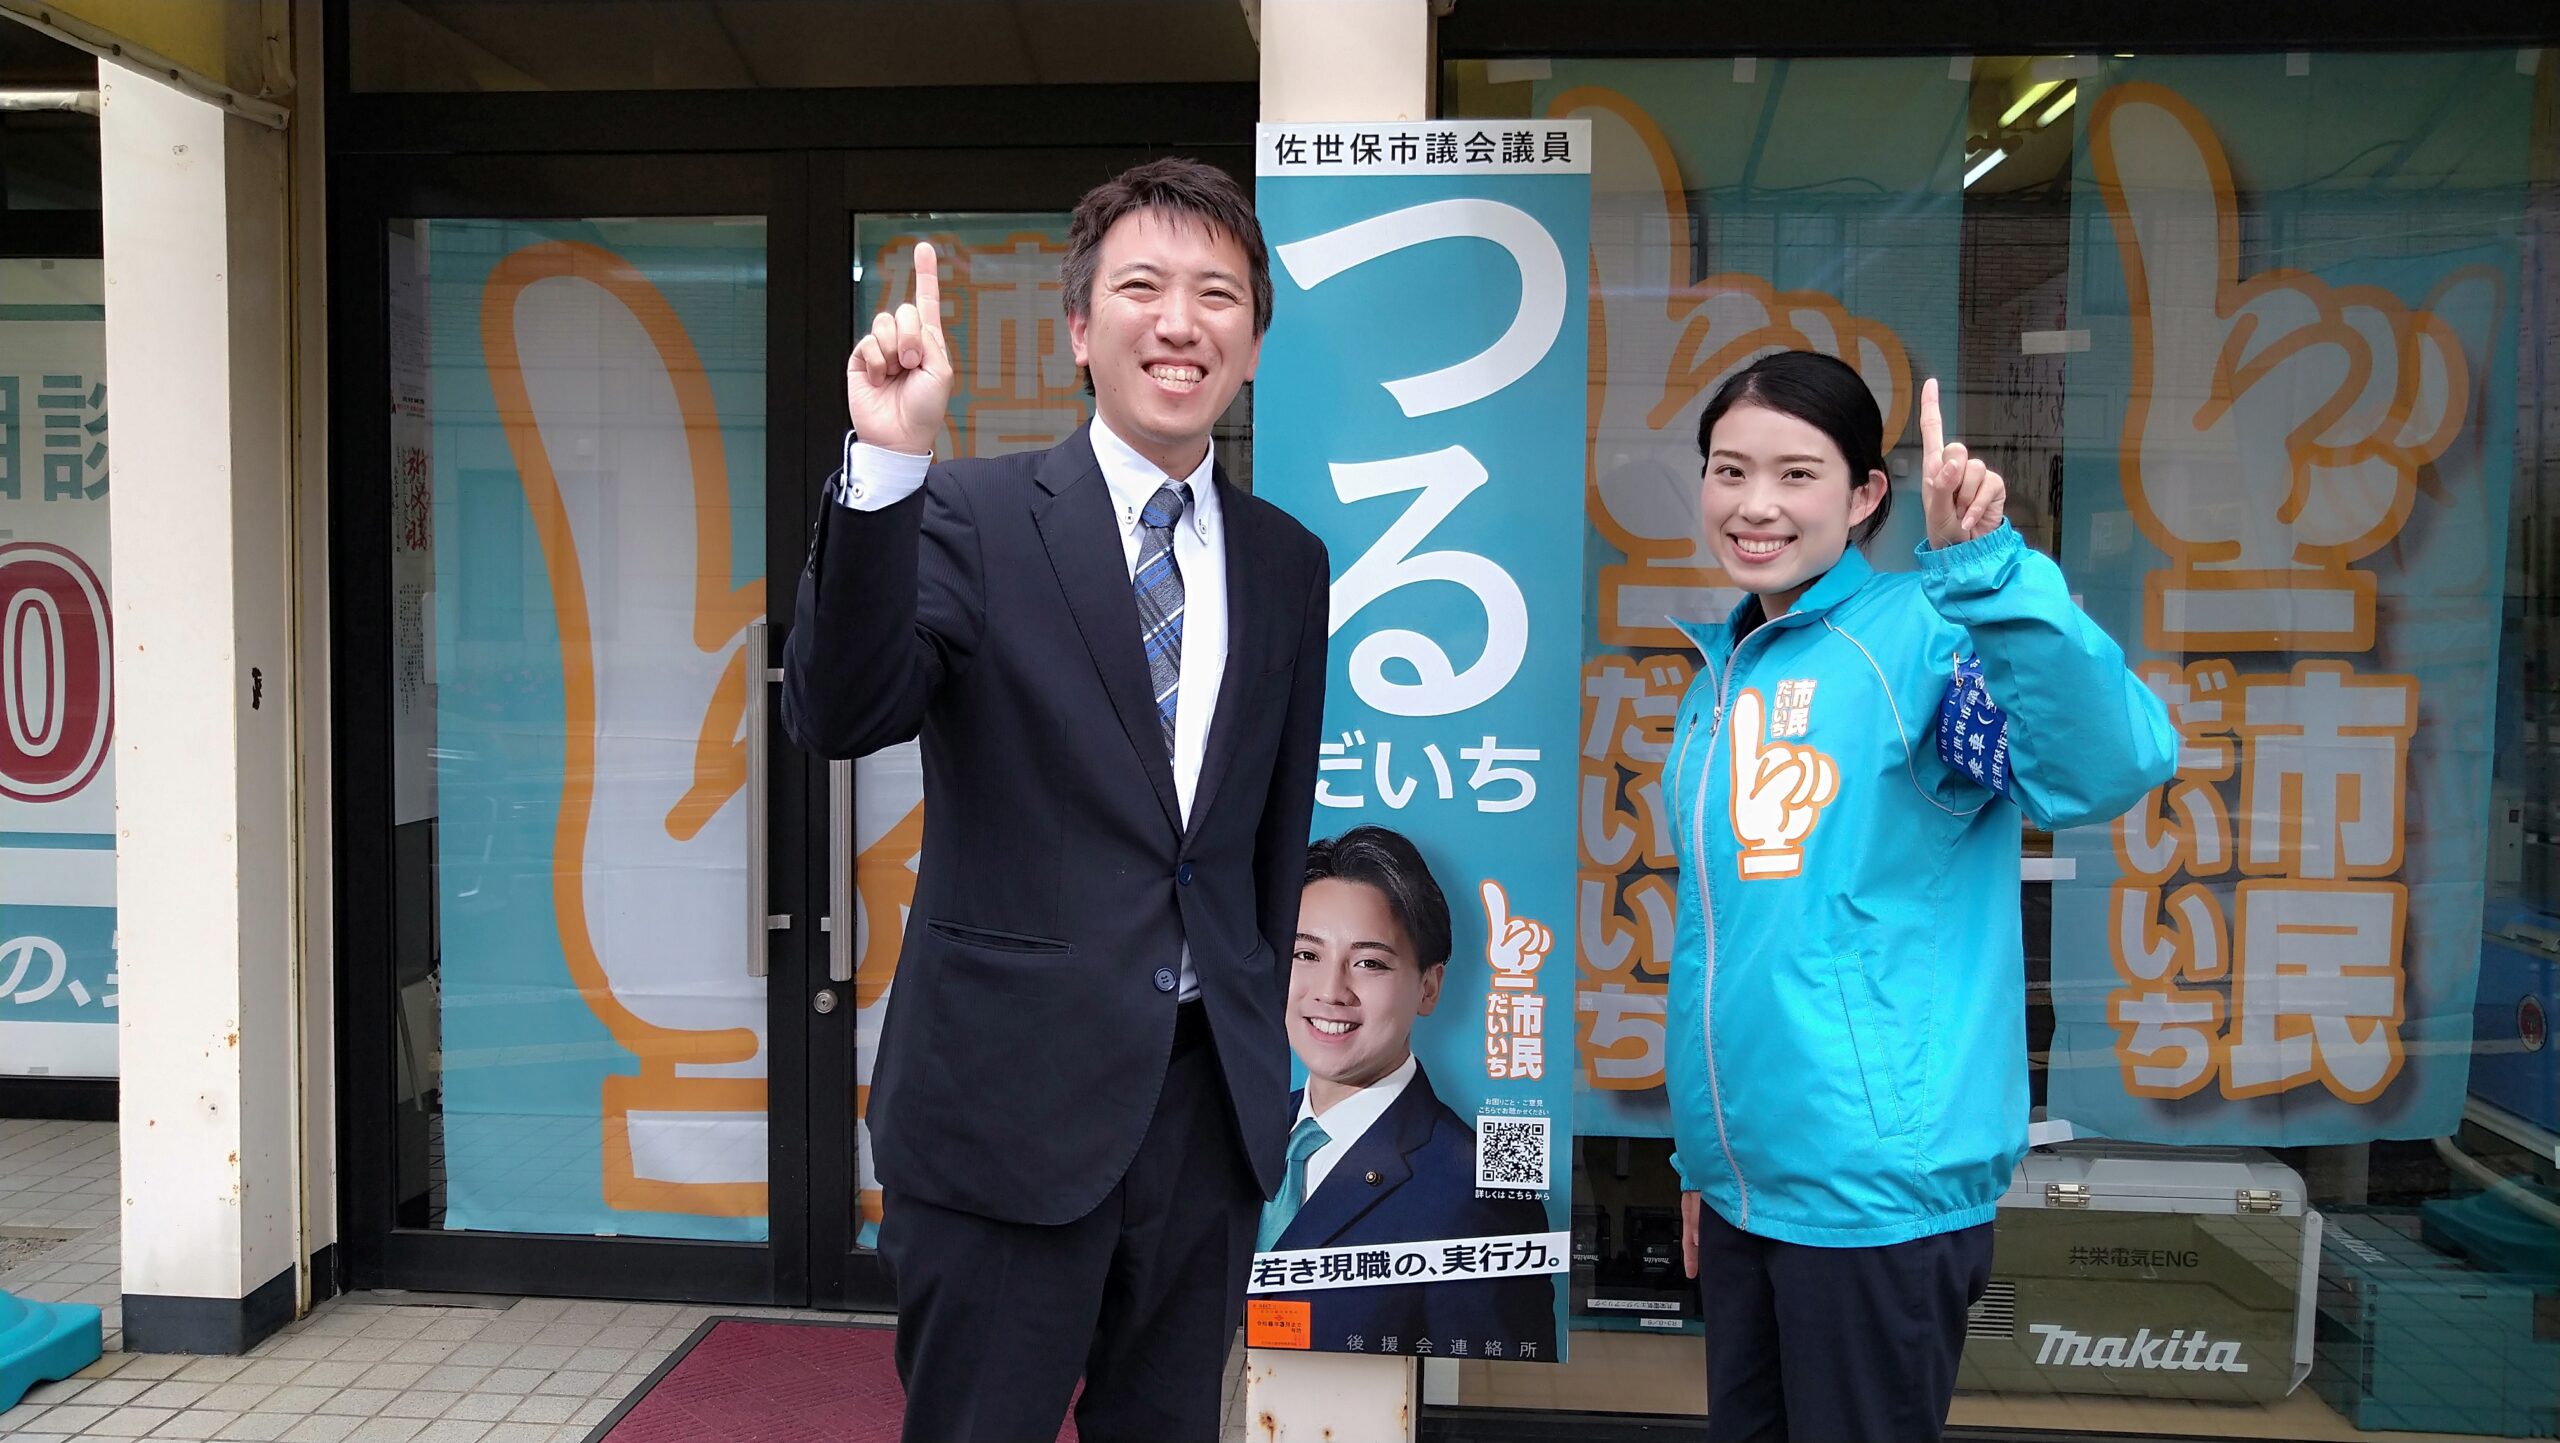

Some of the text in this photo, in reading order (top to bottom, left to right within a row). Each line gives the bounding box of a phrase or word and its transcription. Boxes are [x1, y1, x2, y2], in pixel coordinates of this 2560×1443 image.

[1275, 131, 1572, 165] 佐世保市議会議員
[1275, 199, 1567, 716] つる
[1786, 680, 1816, 737] 市民
[2231, 671, 2406, 1093] 市民
[1487, 993, 1509, 1077] だいいち
[1510, 994, 1544, 1079] 市民
[1253, 1241, 1559, 1287] 若き現職の、実行力。
[2068, 1246, 2199, 1267] 共栄電気ENG
[1346, 1334, 1537, 1358] 後援会連絡所
